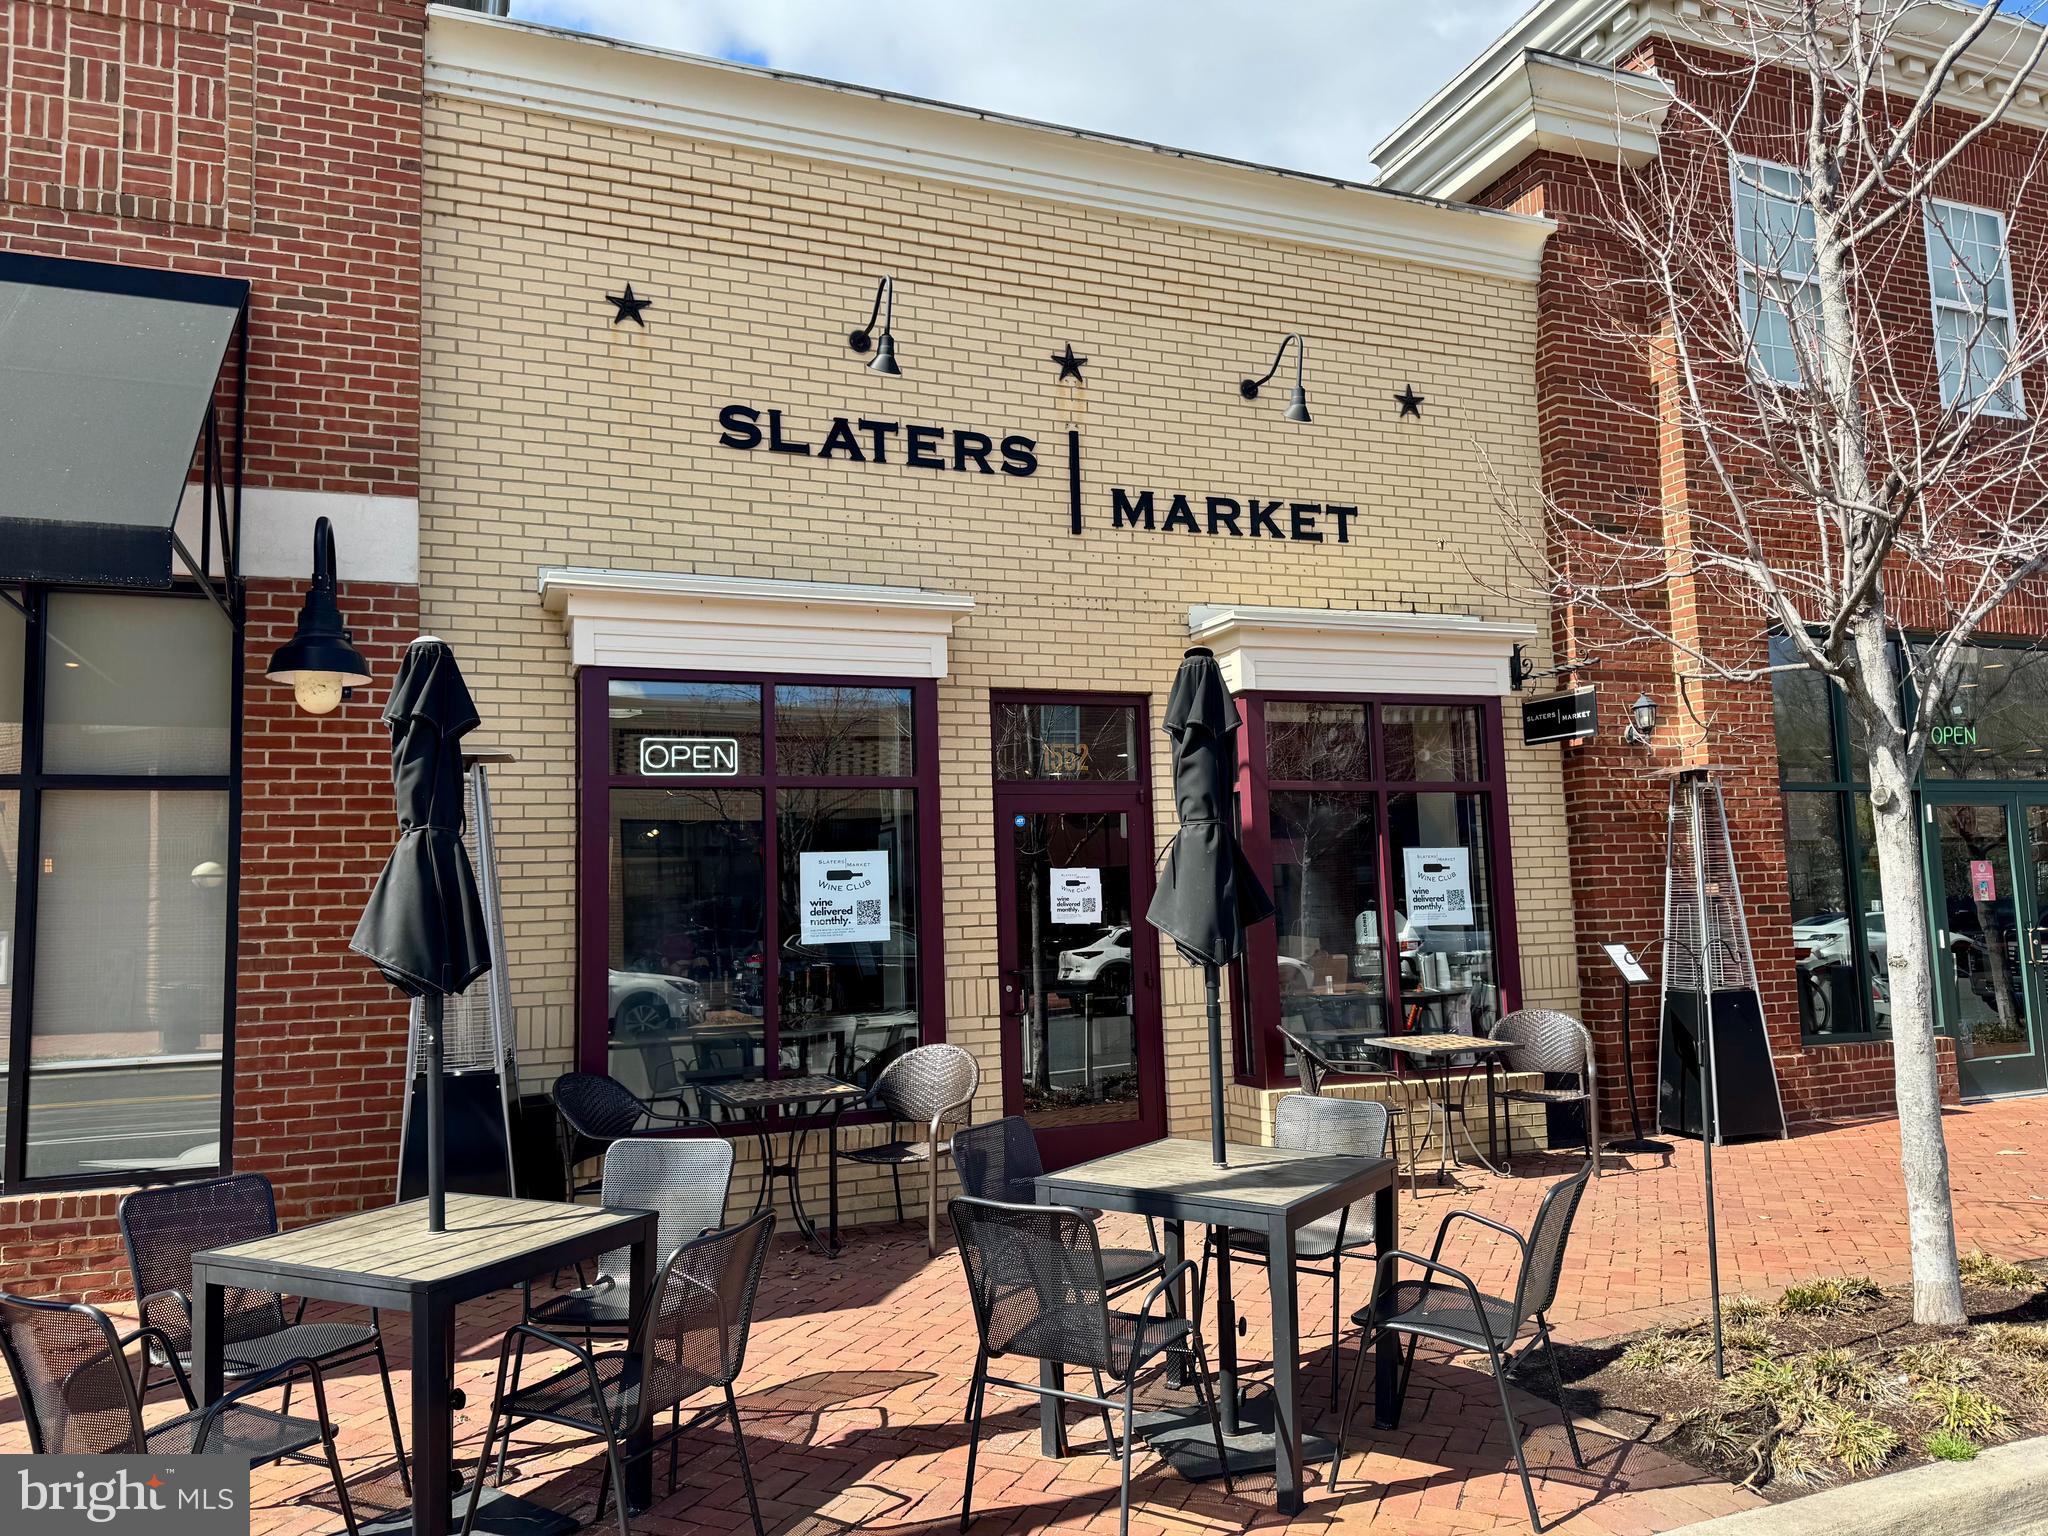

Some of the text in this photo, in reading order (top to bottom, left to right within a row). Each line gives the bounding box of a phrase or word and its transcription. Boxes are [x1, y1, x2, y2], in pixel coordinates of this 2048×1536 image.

[718, 404, 1358, 544] SLATERS MARKET
[1526, 710, 1591, 722] SLATERS MARKET
[1931, 726, 1976, 745] OPEN
[645, 745, 734, 768] OPEN
[1412, 887, 1430, 895] wine
[809, 897, 833, 907] wine
[1412, 894, 1445, 903] delivered
[809, 905, 853, 916] delivered
[1413, 902, 1444, 912] monthly.
[810, 915, 851, 927] monthly.
